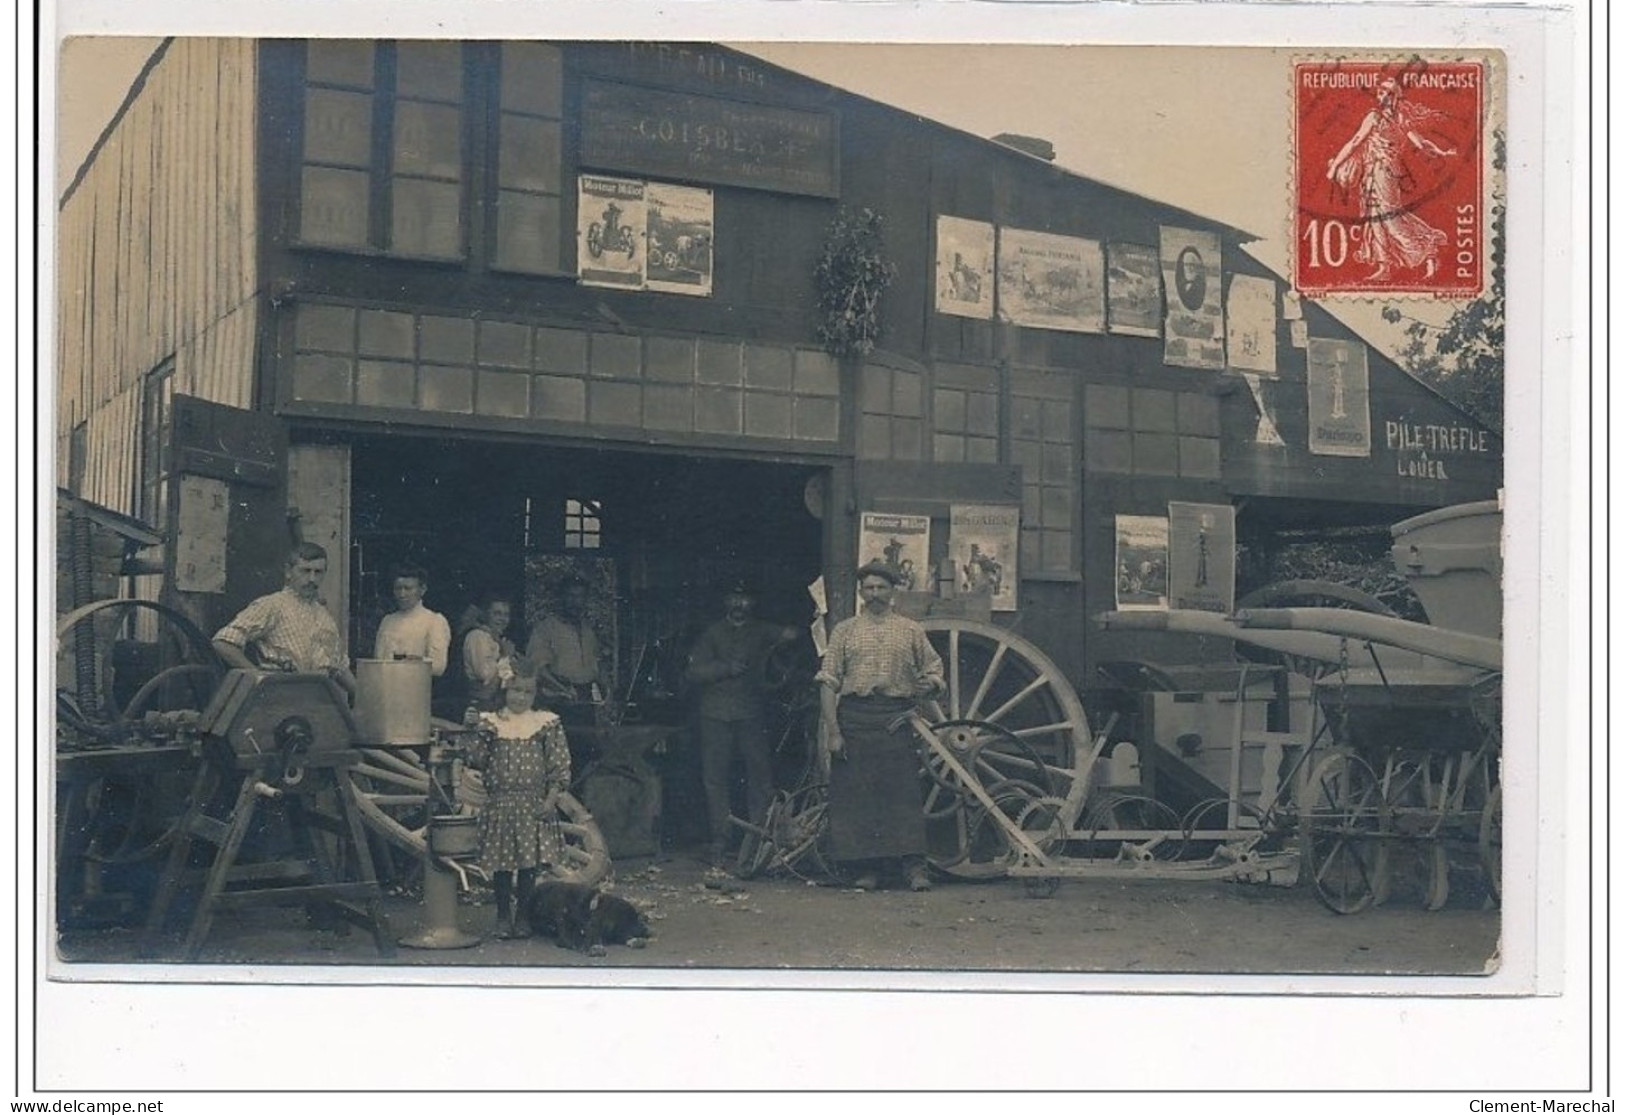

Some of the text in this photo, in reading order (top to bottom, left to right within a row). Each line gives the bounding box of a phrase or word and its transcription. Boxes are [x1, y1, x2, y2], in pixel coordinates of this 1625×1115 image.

[1403, 72, 1475, 91] FRANÇAISE
[1457, 204, 1475, 279] POSTES
[1398, 459, 1449, 480] LOUER
